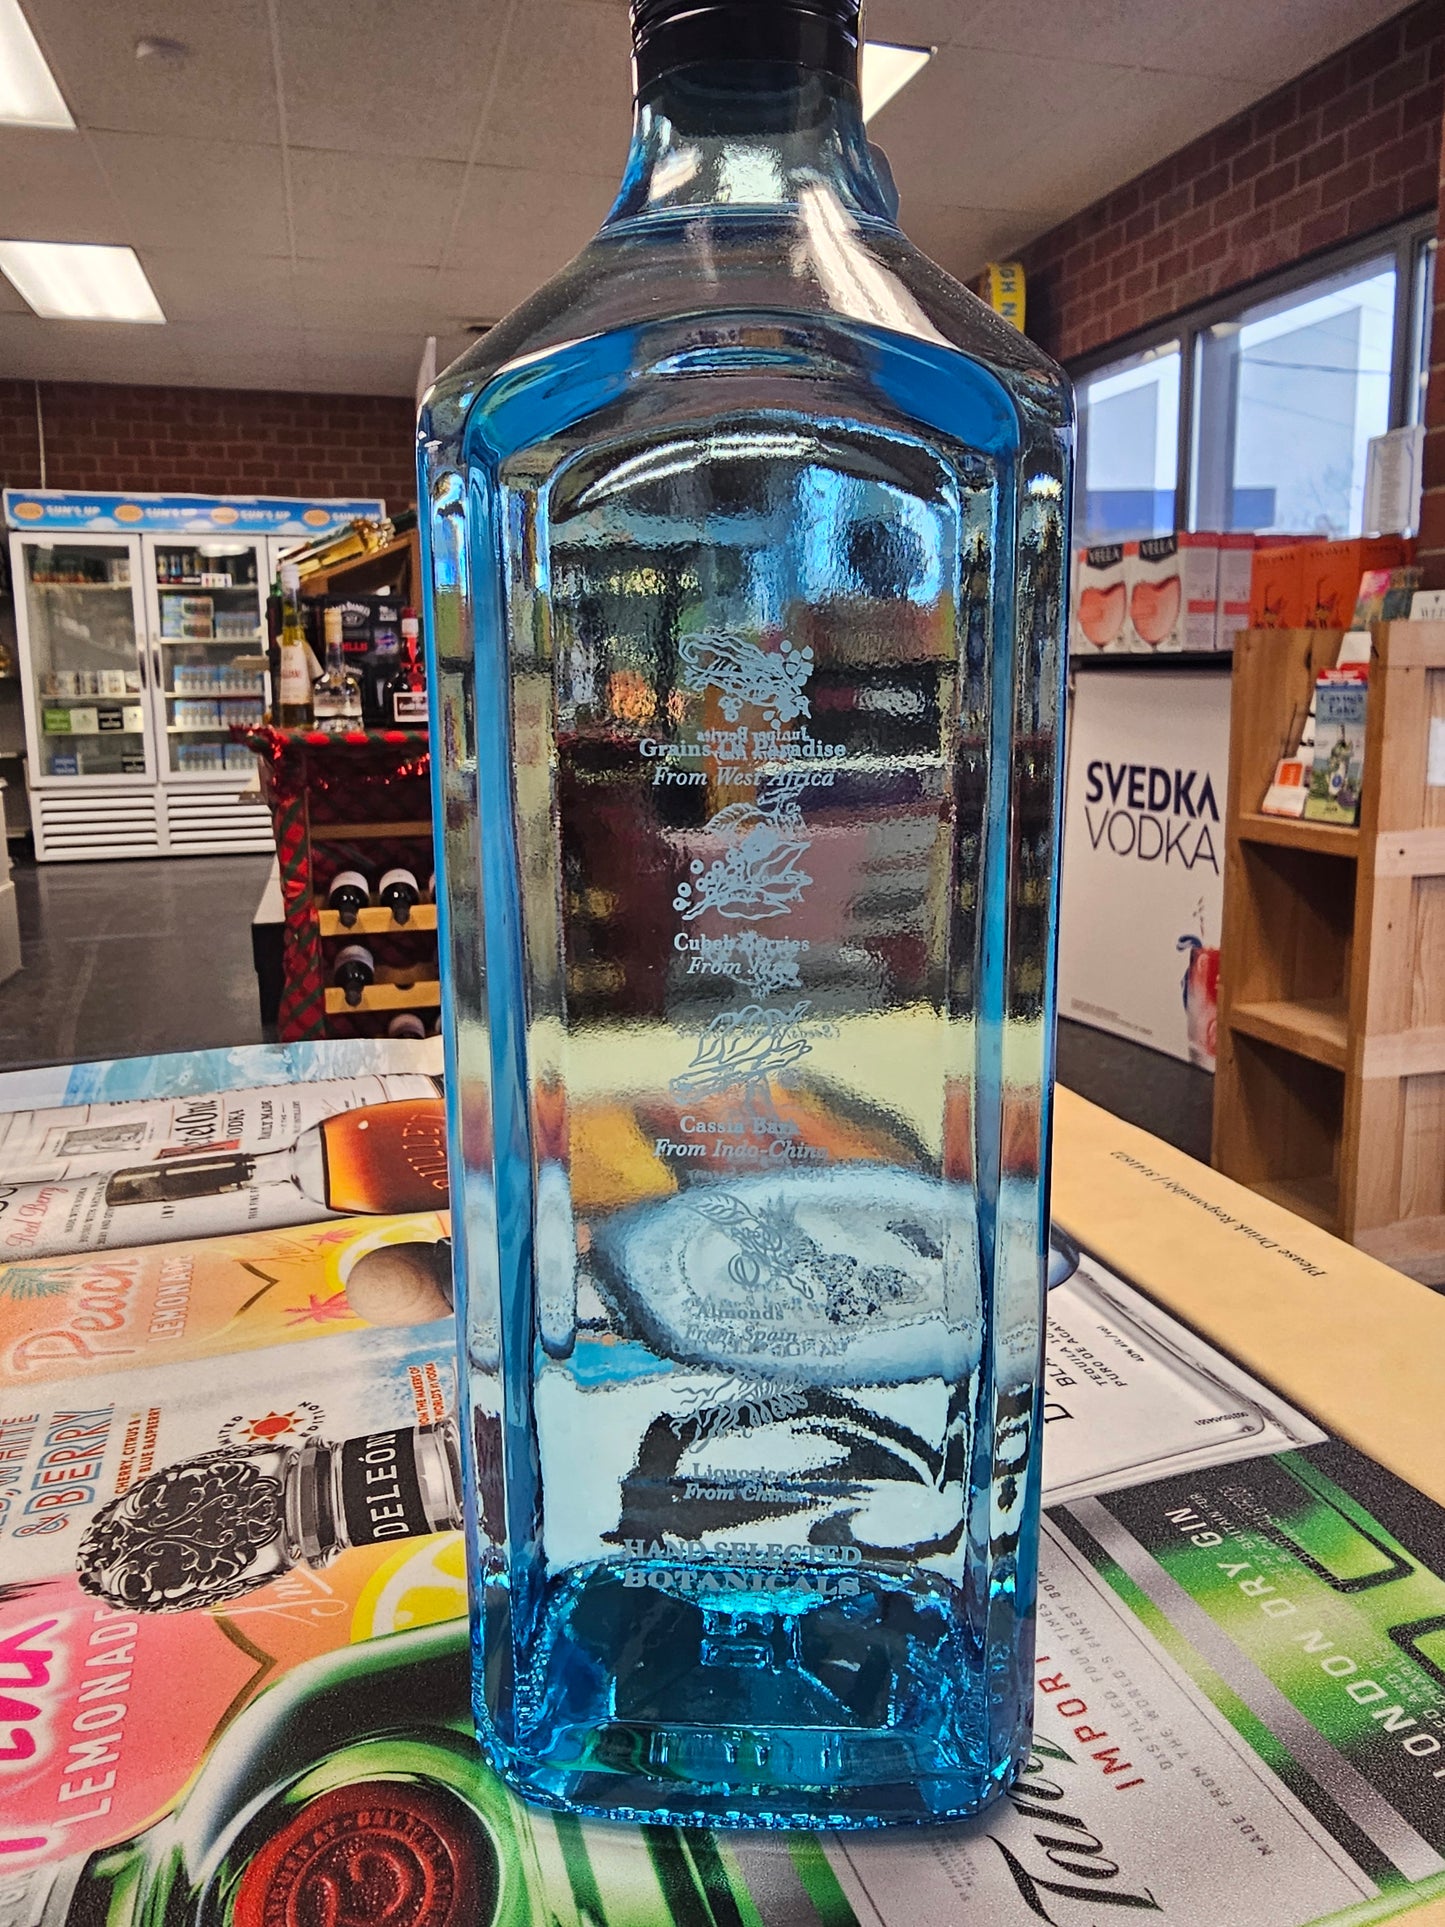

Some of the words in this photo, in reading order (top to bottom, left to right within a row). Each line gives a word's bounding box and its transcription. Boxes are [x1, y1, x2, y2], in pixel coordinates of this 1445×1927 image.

[639, 738, 713, 758] Grains
[751, 739, 847, 759] Paradise
[651, 766, 708, 787] From
[715, 766, 762, 786] West
[766, 768, 835, 790] Africa
[1085, 759, 1220, 823] SVEDKA
[1084, 805, 1220, 875] VODKA
[686, 956, 742, 975] From
[679, 1115, 745, 1135] Cassia
[653, 1138, 707, 1158] From
[711, 1139, 829, 1161] Indo-China
[18, 1186, 69, 1217] Berry
[1161, 1180, 1237, 1225] Responsibly
[5, 1217, 43, 1249] Red
[1233, 1223, 1281, 1250] Drink
[1277, 1248, 1329, 1278] Please
[149, 1253, 195, 1343] LEMONADE
[697, 1302, 785, 1321] Almonds
[12, 1256, 142, 1371] Peach
[742, 1325, 799, 1346] Spain
[1046, 1316, 1080, 1345] AGAV
[1059, 1346, 1108, 1387] TEQUILA
[1074, 1346, 1095, 1360] DE
[410, 1374, 427, 1399] MAKERS
[424, 1363, 439, 1381] VODKA
[1091, 1360, 1128, 1388] PURO
[122, 1427, 141, 1456] CITRUS
[143, 1407, 162, 1450] RASPBERRY
[23, 1405, 116, 1516] BERRY
[138, 1449, 156, 1474] BLUE
[691, 1463, 790, 1484] Liquorice
[357, 1433, 410, 1539] DELEÓN
[683, 1483, 735, 1501] From
[738, 1483, 801, 1503] China
[11, 1511, 71, 1538] &
[1164, 1506, 1224, 1549] GIN
[1208, 1510, 1258, 1551] BRITAIN
[623, 1538, 710, 1562] HAND
[713, 1541, 863, 1567] SELECTED
[622, 1568, 861, 1597] BOTANICALS
[1216, 1560, 1297, 1619] DRY
[1037, 1601, 1072, 1643] TIMES
[1058, 1604, 1103, 1650] FINEST
[1068, 1647, 1105, 1685] FOUR
[51, 1606, 139, 1828] LEMONADE
[1103, 1689, 1175, 1771] DISTILLED
[1159, 1726, 1193, 1761] THE
[1230, 1814, 1274, 1858] MADE
